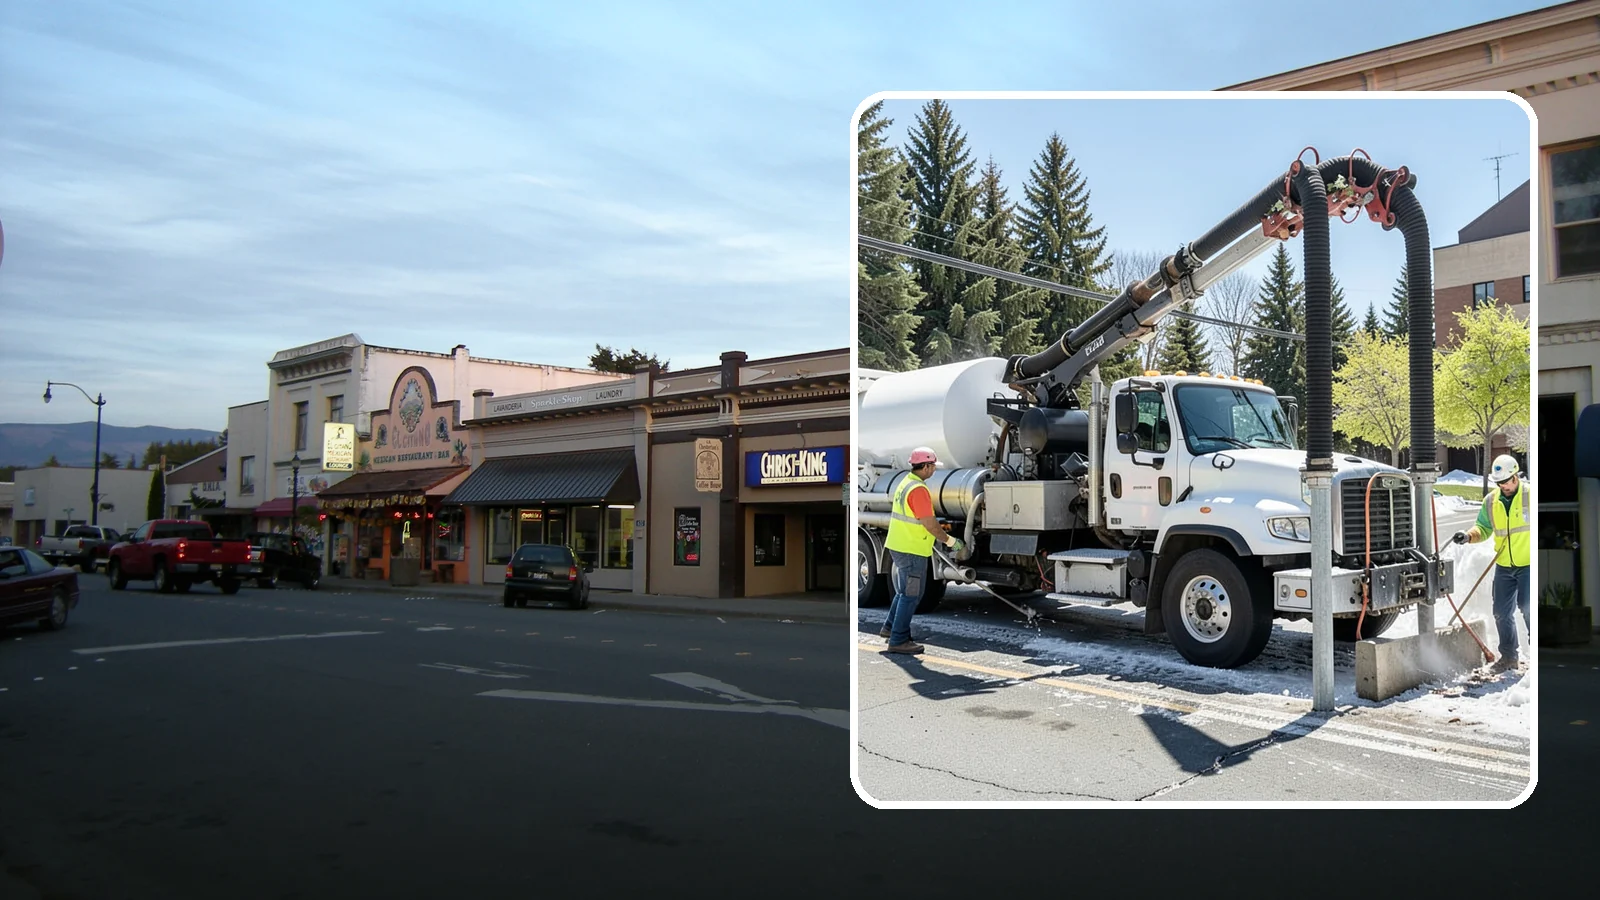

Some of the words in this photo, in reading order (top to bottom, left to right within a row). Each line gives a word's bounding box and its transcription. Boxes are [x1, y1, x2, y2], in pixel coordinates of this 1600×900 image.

[531, 397, 561, 409] Sparkle
[561, 394, 583, 405] Shop
[595, 389, 624, 400] LAUNDRY
[493, 402, 522, 413] LAVANDERIA
[397, 451, 433, 463] RESTAURANT
[438, 449, 450, 459] BAR
[761, 452, 797, 477] CHRIST
[799, 450, 827, 477] KING
